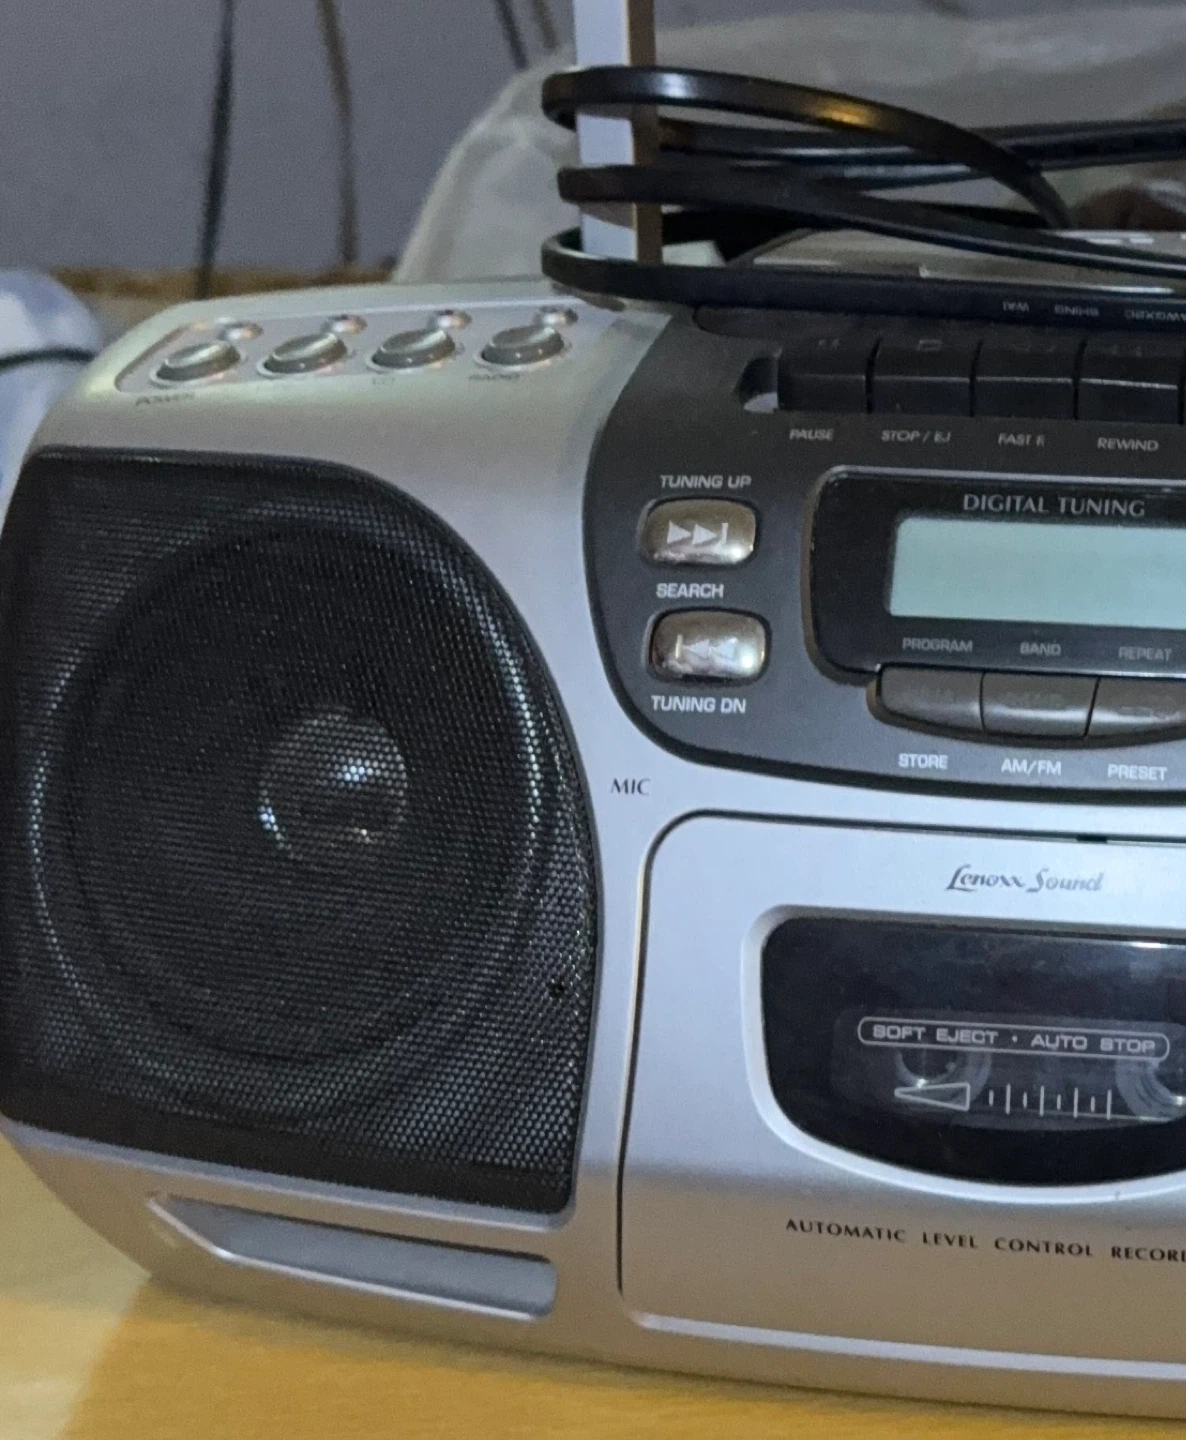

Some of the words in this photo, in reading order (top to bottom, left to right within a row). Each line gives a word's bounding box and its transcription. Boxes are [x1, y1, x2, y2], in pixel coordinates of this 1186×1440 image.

[789, 428, 834, 441] PAUSE
[881, 429, 920, 442] STOP
[998, 433, 1030, 445] FAST
[1097, 437, 1159, 452] REWIND
[660, 474, 723, 489] TUNING
[728, 474, 752, 489] UP
[962, 494, 1050, 513] DIGITAL
[1057, 496, 1146, 517] TUNING
[656, 583, 724, 600] SEARCH
[902, 638, 973, 653] PROGRAM
[1020, 641, 1061, 657] BAND
[1118, 645, 1172, 662] REPEAT
[651, 695, 716, 713] TUNING
[720, 696, 746, 714] DN
[898, 753, 948, 770] STORE
[1001, 758, 1061, 776] AM/FM
[1107, 763, 1168, 782] PRESET
[611, 778, 651, 796] MIC
[945, 863, 1025, 892] Lenoxx
[1026, 867, 1104, 893] Sound
[872, 1024, 926, 1041] SOFT
[935, 1026, 998, 1046] EJECT
[1031, 1033, 1088, 1051] AUTO
[1099, 1036, 1156, 1054] STOP
[786, 1218, 906, 1243] AUTOMATIC
[922, 1231, 978, 1250] LEVEL
[994, 1237, 1093, 1257] CONTROL
